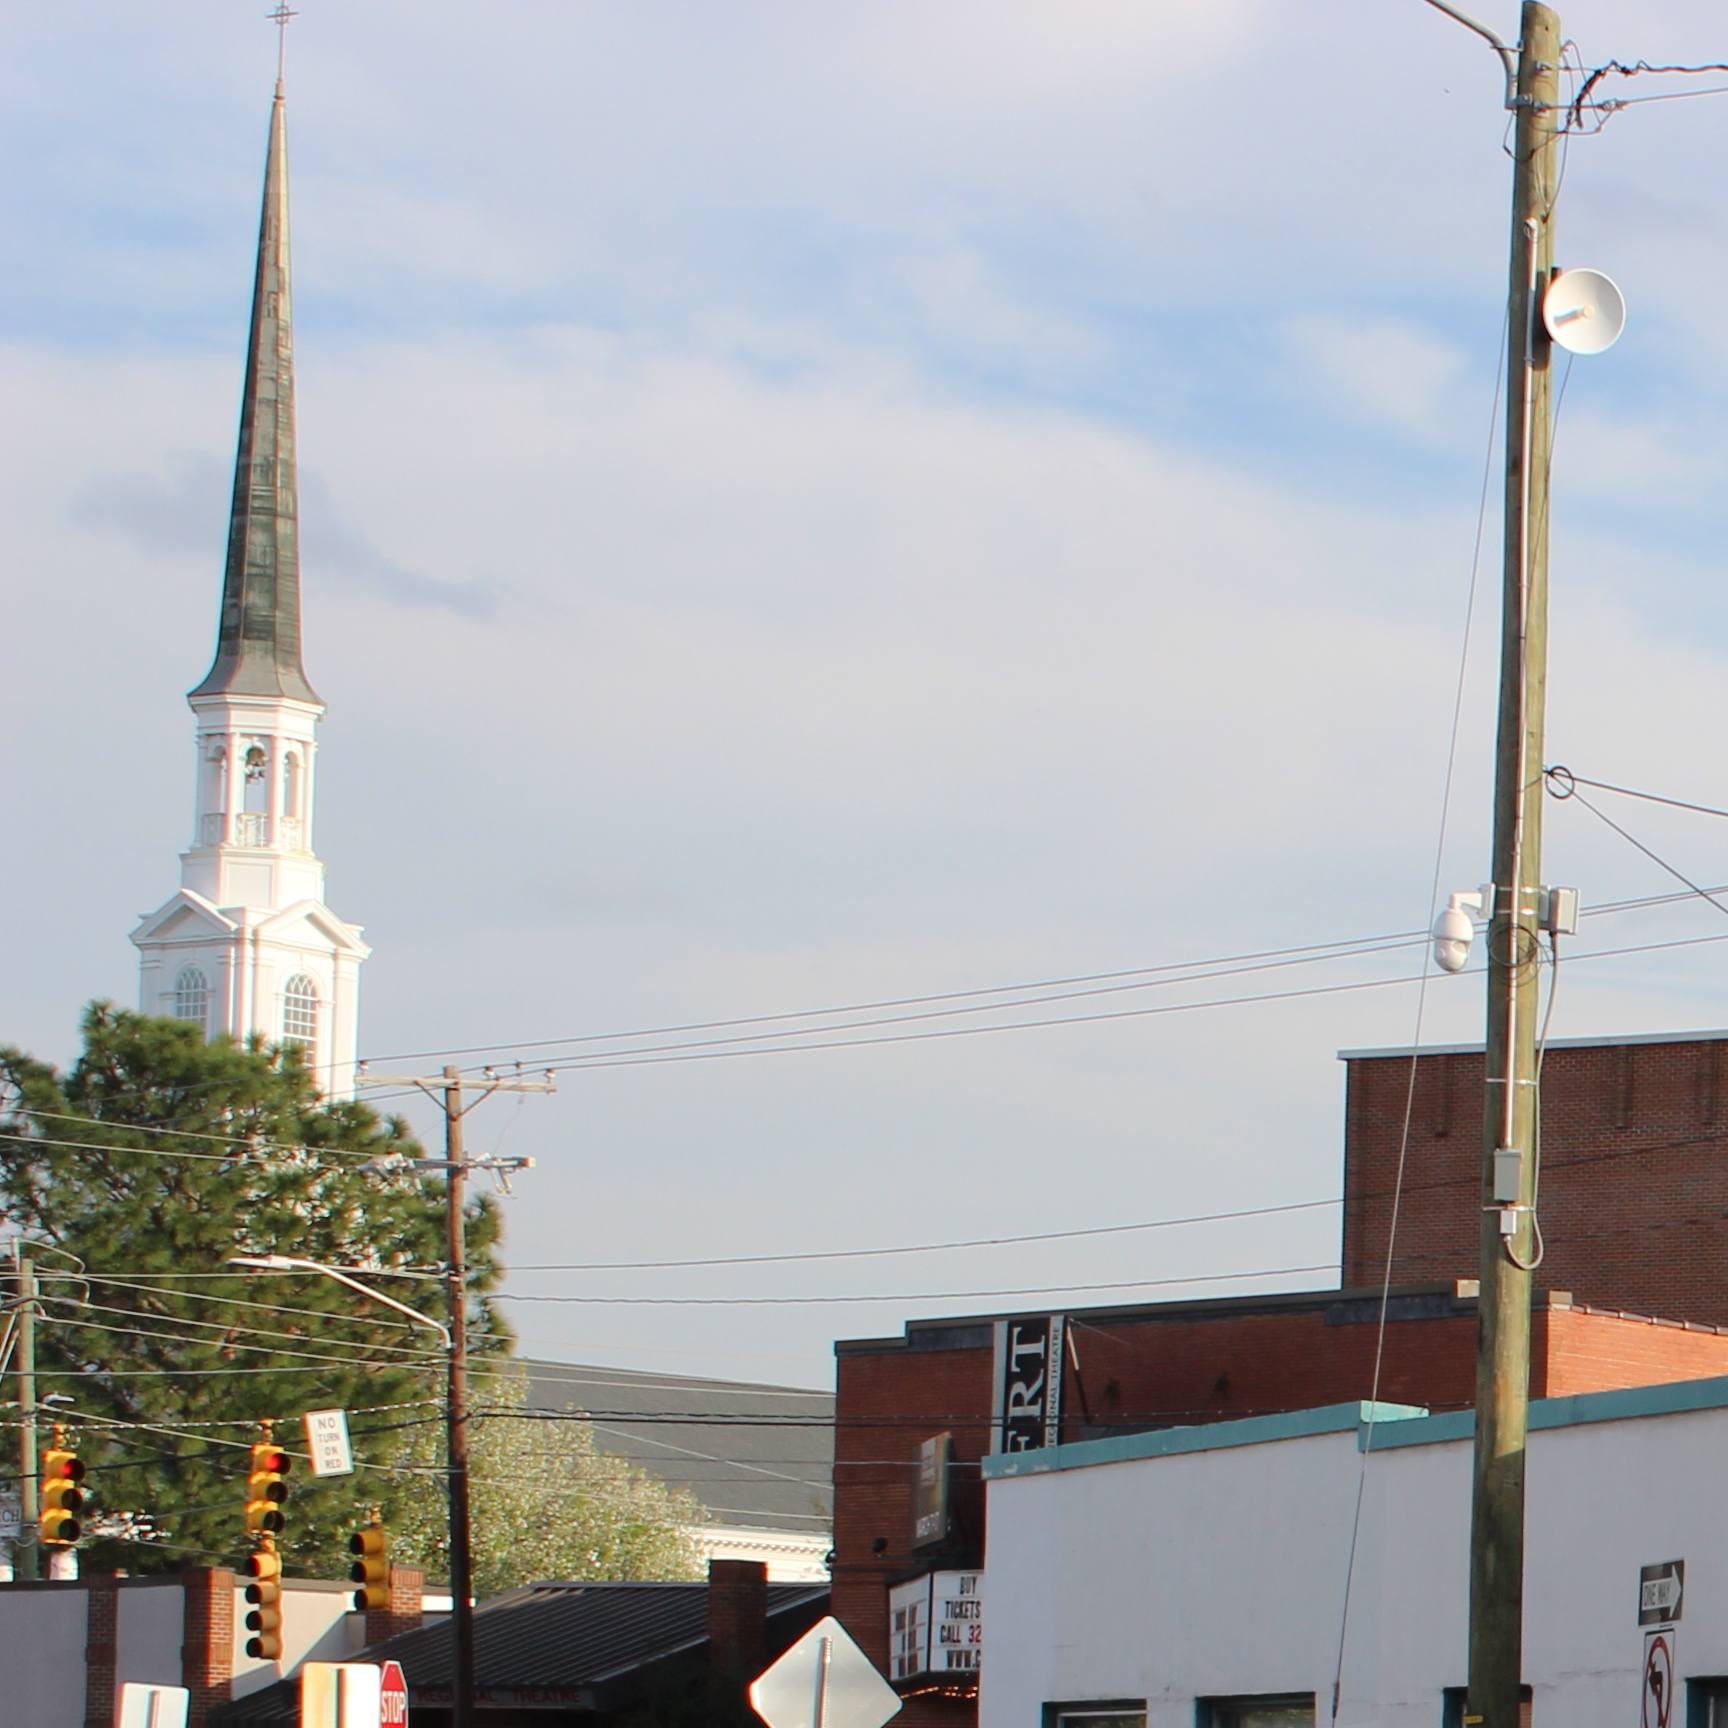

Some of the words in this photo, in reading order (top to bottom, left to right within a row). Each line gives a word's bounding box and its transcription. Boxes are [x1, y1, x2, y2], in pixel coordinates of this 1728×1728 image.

[317, 1417, 336, 1430] NO
[317, 1433, 341, 1443] TURN
[324, 1446, 338, 1456] ON
[325, 1459, 342, 1469] RED
[960, 1575, 977, 1595] BUY
[945, 1600, 982, 1619] TICKETS
[940, 1625, 961, 1644] CALL
[511, 1689, 582, 1703] THEATRE
[381, 1691, 406, 1723] STOP
